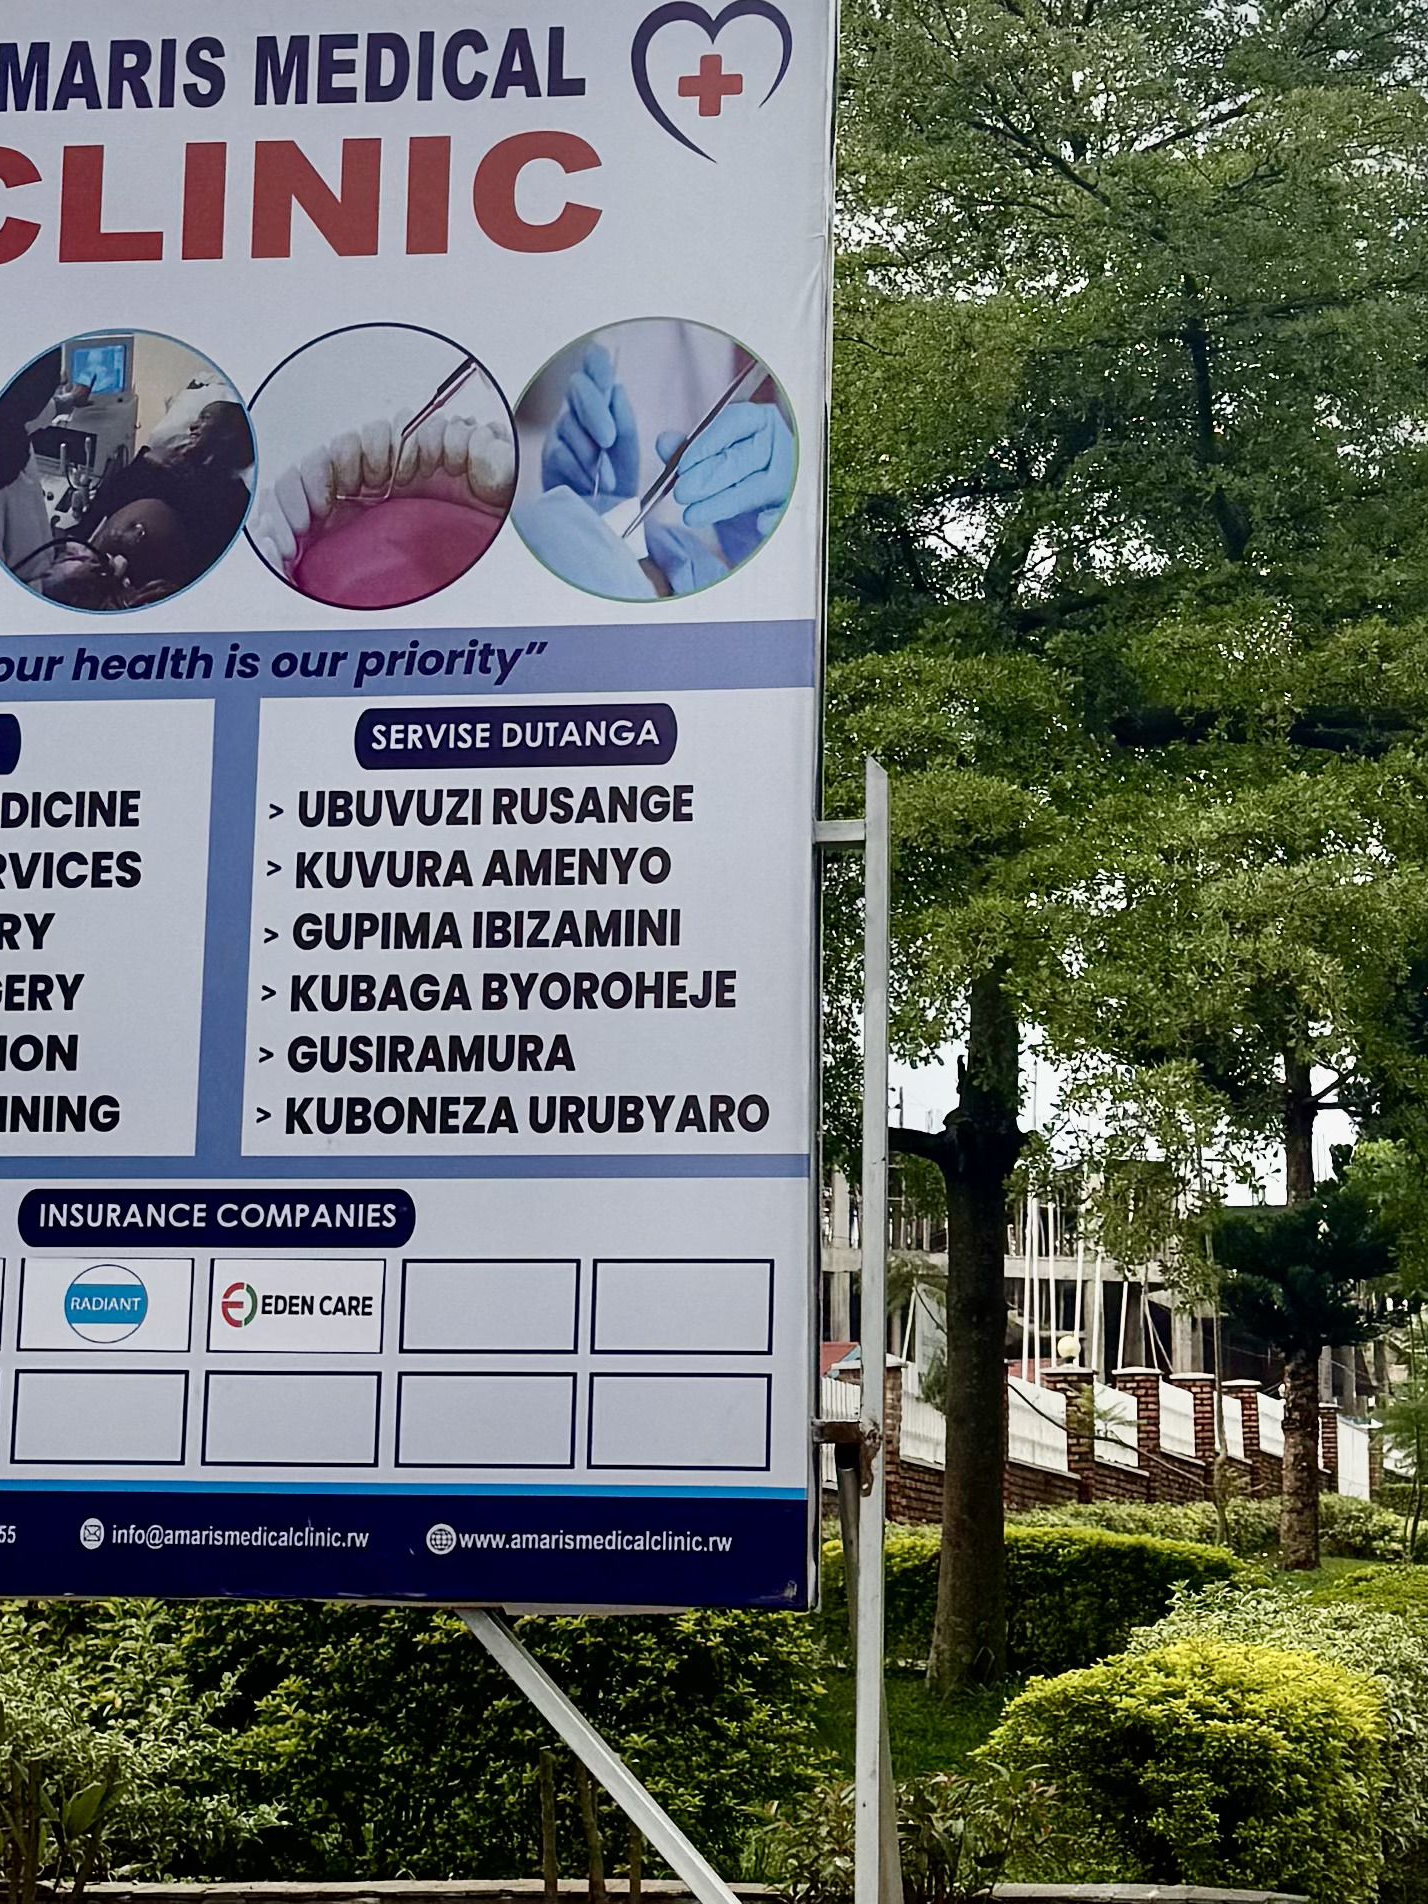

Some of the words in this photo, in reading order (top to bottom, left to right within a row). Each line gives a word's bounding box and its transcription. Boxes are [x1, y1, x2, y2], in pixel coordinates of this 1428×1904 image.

[255, 27, 585, 105] MEDICAL
[72, 646, 213, 680] health
[225, 643, 260, 678] is
[272, 652, 348, 678] our
[372, 723, 490, 749] SERVISE
[503, 720, 659, 747] DUTANGA
[299, 789, 481, 827] UBUVUZI
[493, 785, 693, 824] RUSANGE
[296, 850, 473, 888] KUVURA
[482, 847, 671, 886] AMENYO
[293, 912, 462, 950] GUPIMA
[473, 909, 680, 948] IBIZAMINI
[291, 974, 472, 1011] KUBAGA
[482, 971, 736, 1010] BYOROHEJE
[288, 1034, 575, 1073] GUSIRAMURA
[286, 1096, 518, 1134] KUBONEZA
[529, 1094, 769, 1133] URUBYARO
[40, 1204, 206, 1227] INSURANCE
[217, 1204, 396, 1227] COMPANIES
[71, 1297, 141, 1310] RADIANT
[262, 1295, 314, 1315] EDEN
[320, 1296, 373, 1316] CARE
[113, 1525, 369, 1549] info@amarismedicalclinic.rw
[458, 1530, 732, 1551] www.amarismedicalclinic.rw
